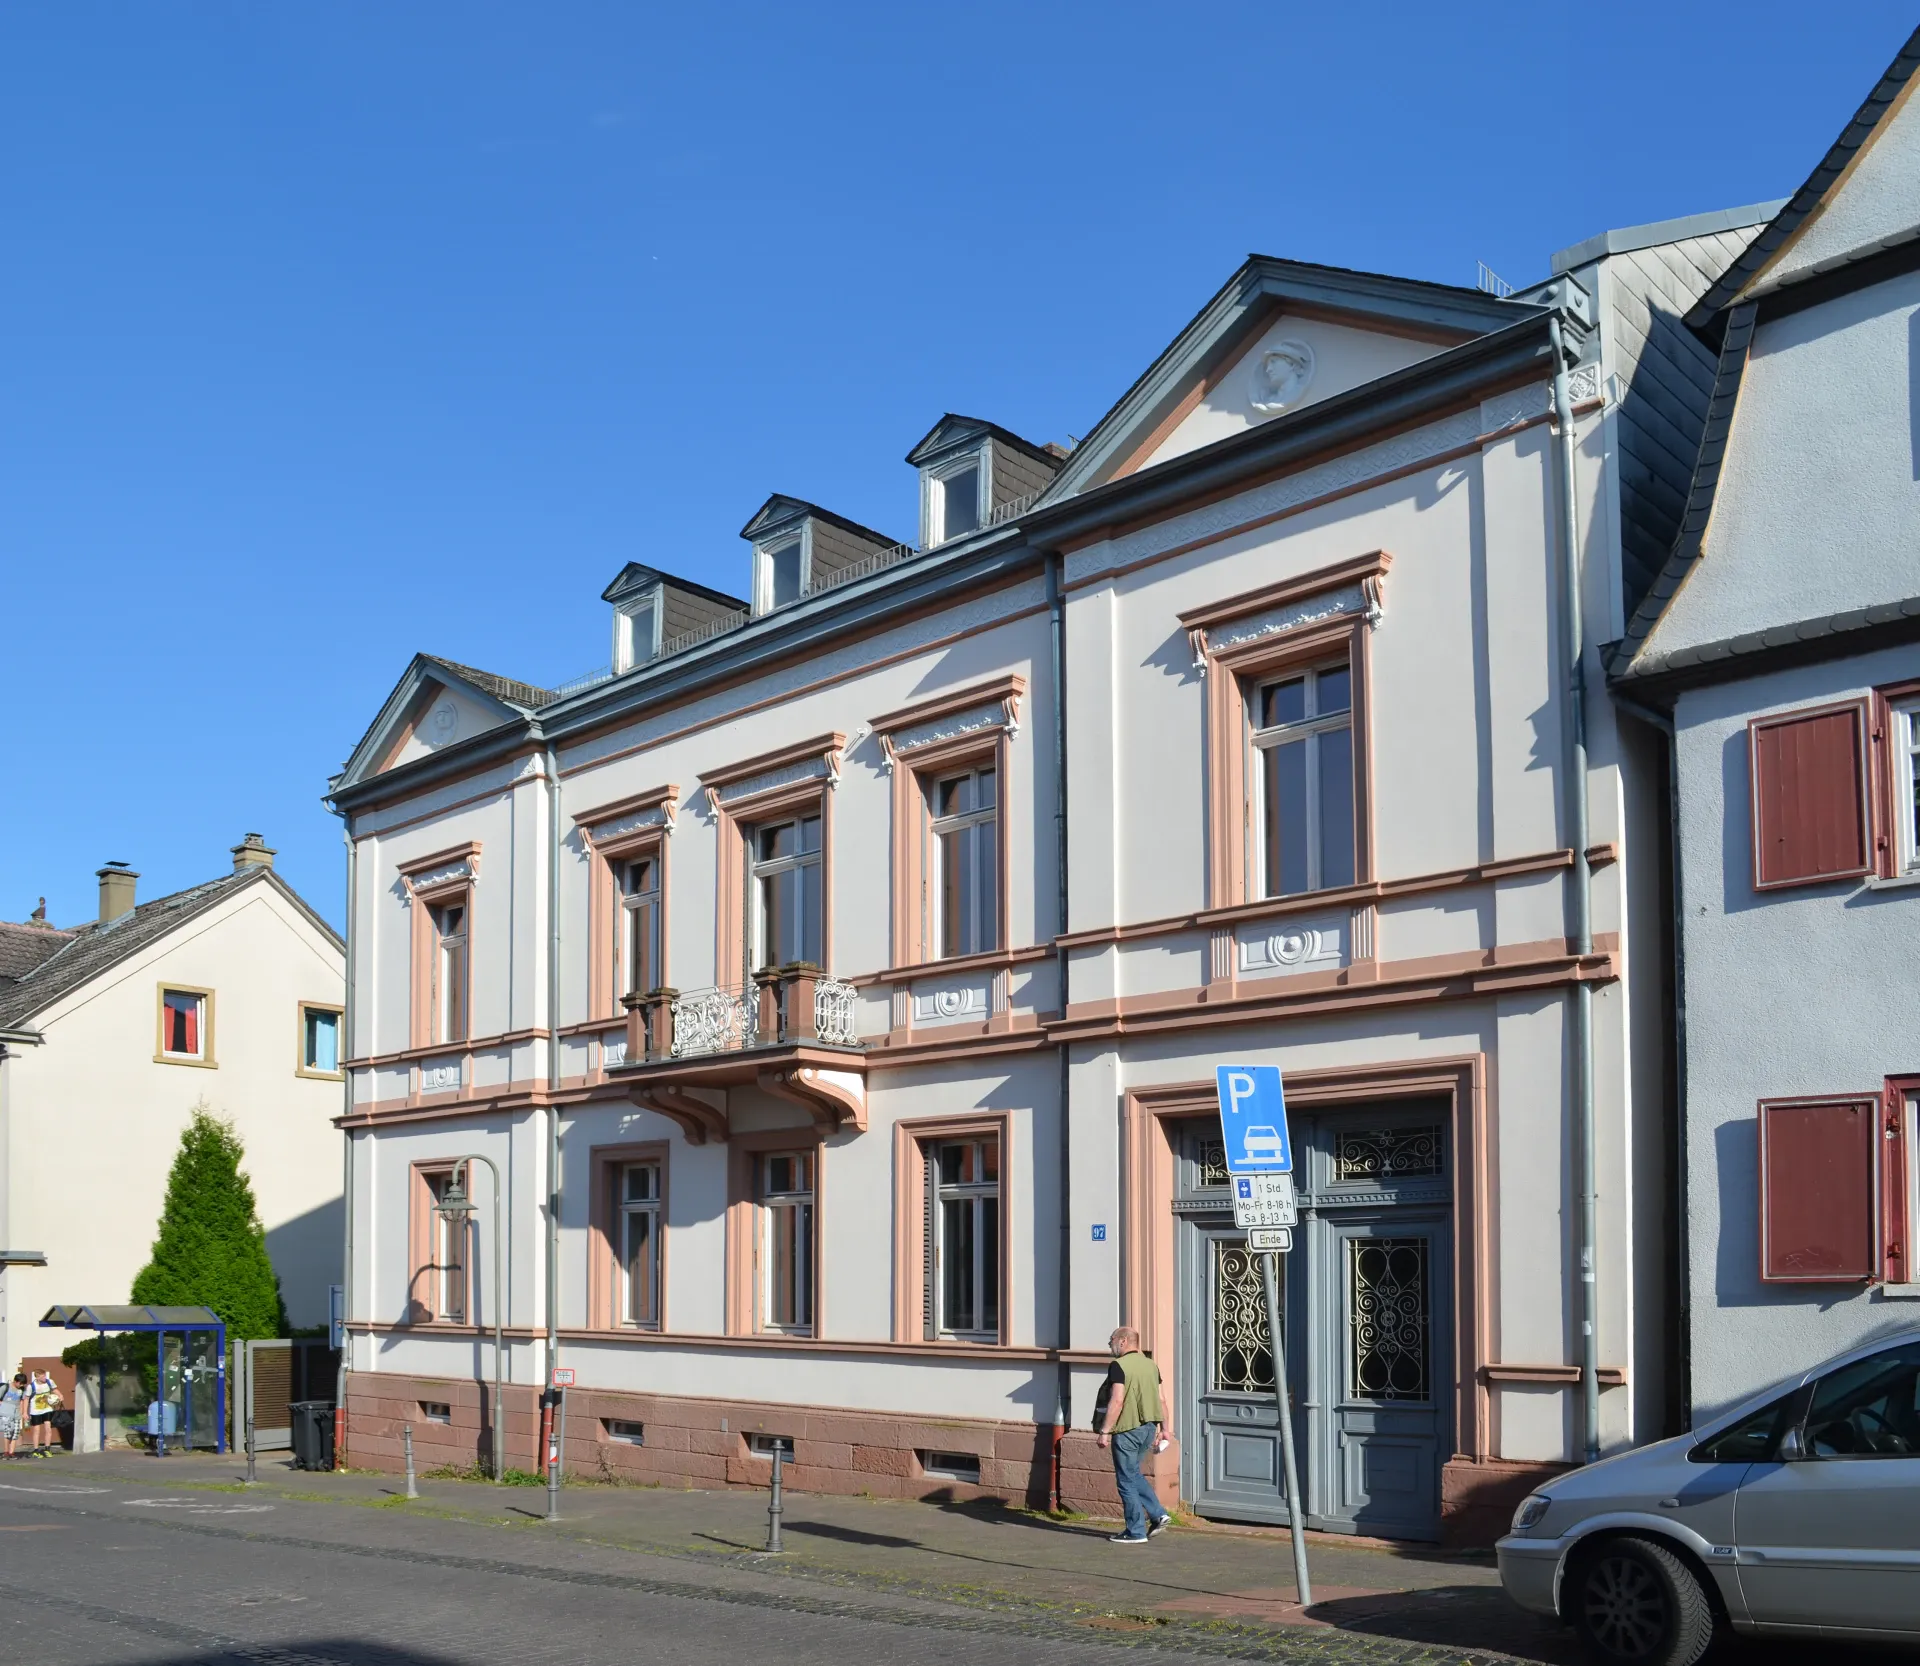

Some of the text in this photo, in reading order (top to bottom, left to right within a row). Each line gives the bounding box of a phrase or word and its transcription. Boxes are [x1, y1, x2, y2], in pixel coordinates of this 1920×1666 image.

[1227, 1072, 1256, 1114] P
[1266, 1183, 1284, 1193] Std.
[1238, 1199, 1292, 1211] Mo-Fr 8-18 h
[1244, 1212, 1289, 1223] Sa 8-13 h
[1259, 1234, 1281, 1244] Ende
